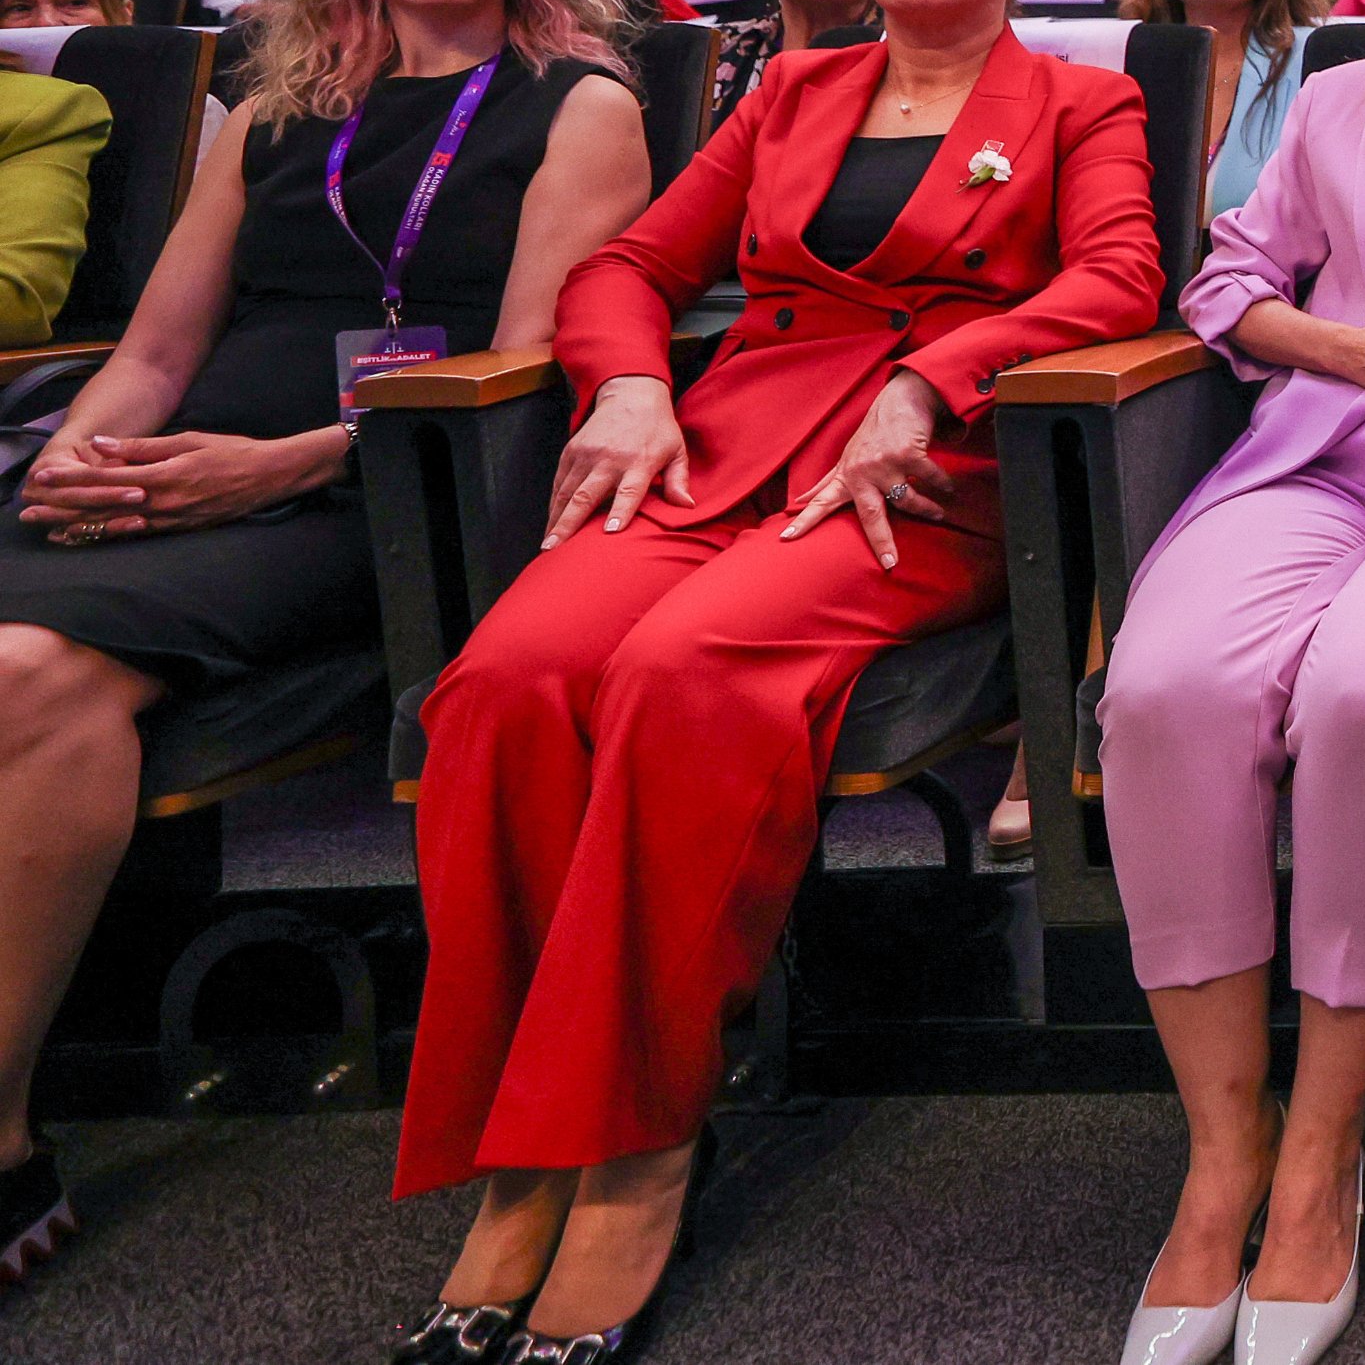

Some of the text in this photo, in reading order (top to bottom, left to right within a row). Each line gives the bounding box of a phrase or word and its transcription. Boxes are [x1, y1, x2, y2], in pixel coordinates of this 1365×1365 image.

[412, 168, 445, 231] KADIN KOLLARI
[397, 353, 431, 361] ADALET
